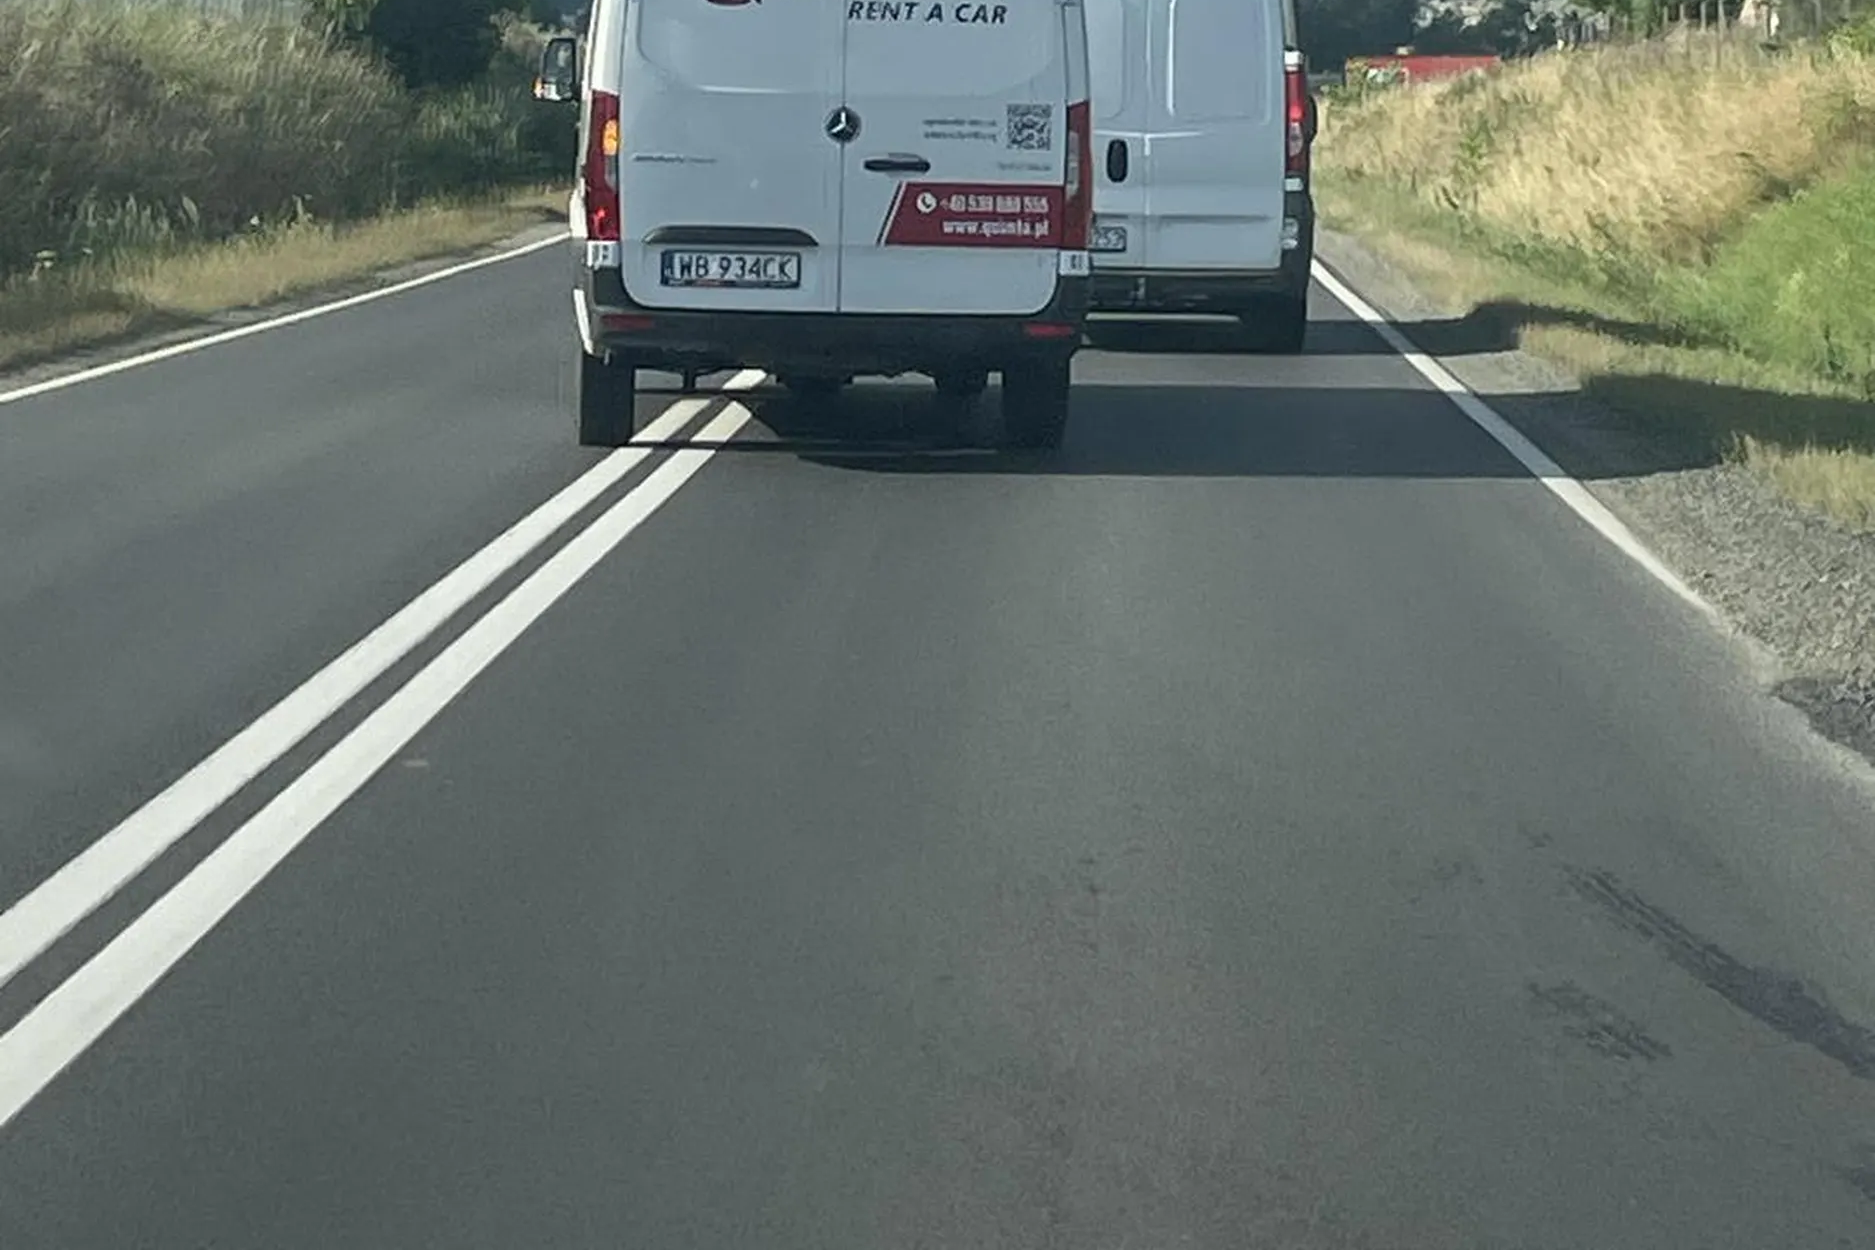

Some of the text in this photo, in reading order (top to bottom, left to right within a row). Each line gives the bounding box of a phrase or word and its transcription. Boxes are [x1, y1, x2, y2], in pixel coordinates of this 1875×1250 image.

[848, 0, 1007, 24] RENT A CAR
[680, 255, 792, 280] WB 934CK
